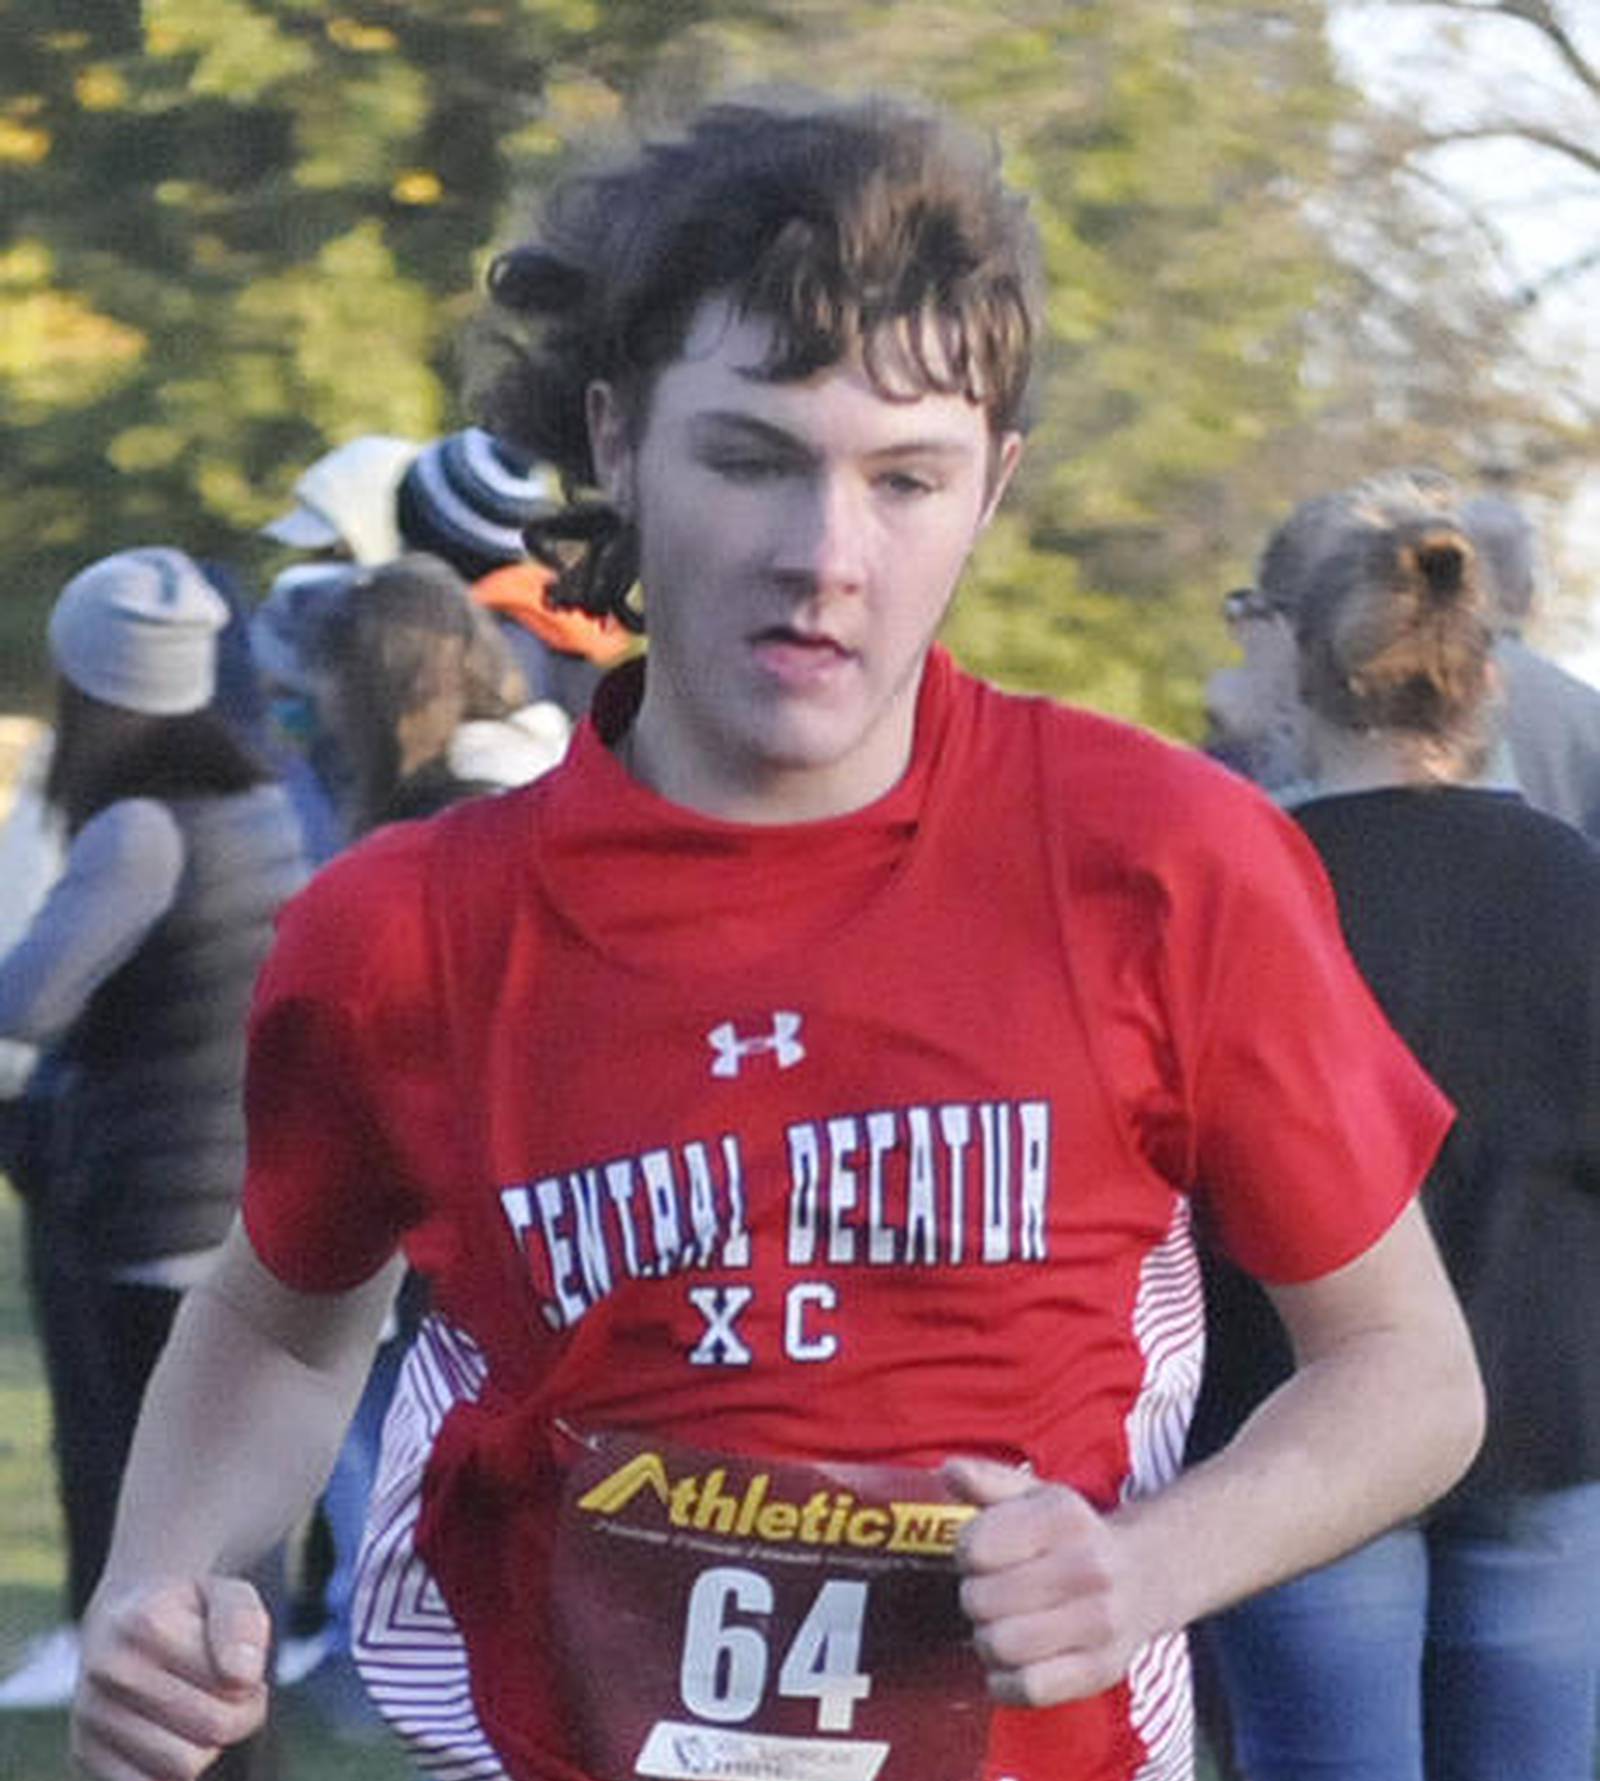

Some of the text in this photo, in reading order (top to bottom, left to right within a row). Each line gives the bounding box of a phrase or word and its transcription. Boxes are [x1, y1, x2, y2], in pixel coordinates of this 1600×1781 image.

[500, 1100, 1051, 1330] CENTRAL DECATUR
[679, 1565, 872, 1733] 64
